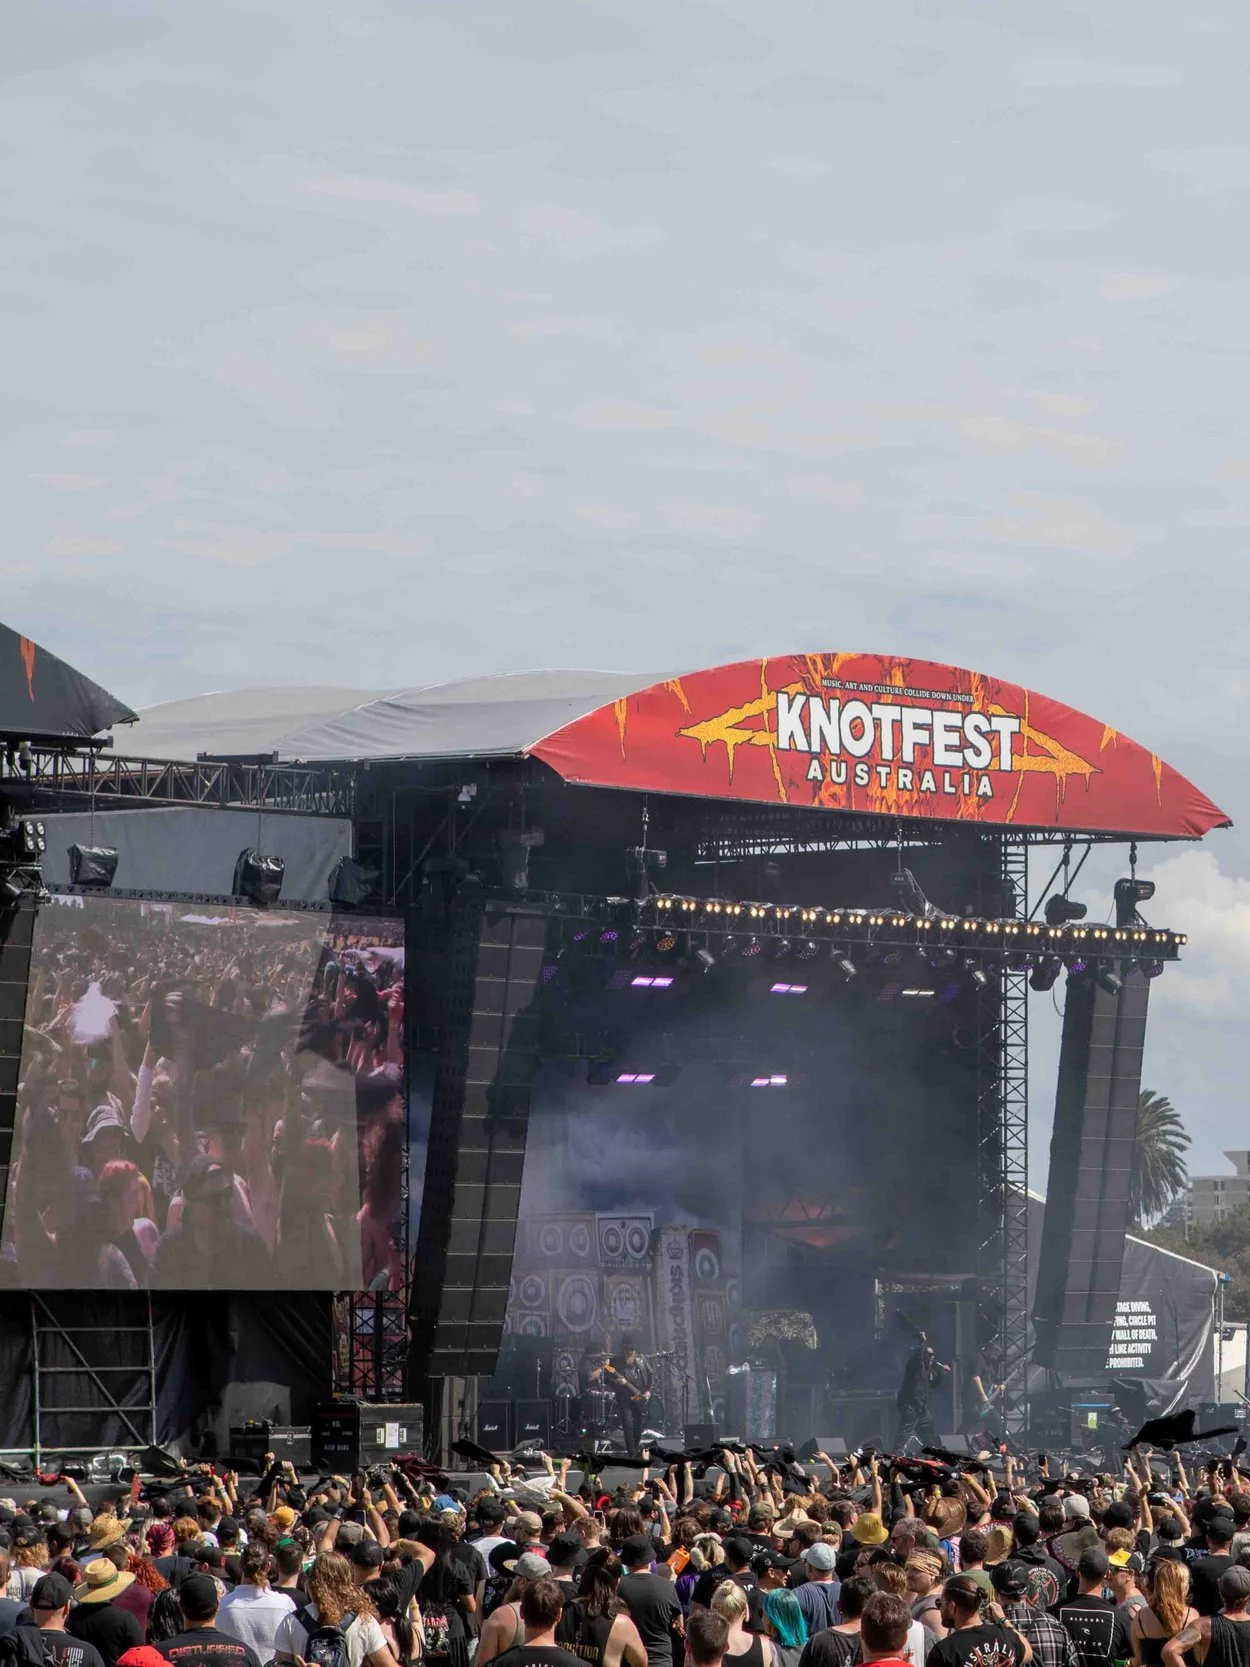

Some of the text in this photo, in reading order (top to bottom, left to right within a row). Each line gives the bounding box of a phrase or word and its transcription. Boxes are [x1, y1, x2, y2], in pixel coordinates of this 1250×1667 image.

[822, 679, 975, 702] MUSIC, ART AND CULTURE COLLIDE DOWN UNDER
[777, 692, 1020, 772] KNOTFEST
[807, 759, 993, 796] AUSTRALIA
[1116, 1330, 1131, 1340] WALL
[1131, 1329, 1139, 1340] OF
[1115, 1343, 1128, 1354] LIKE
